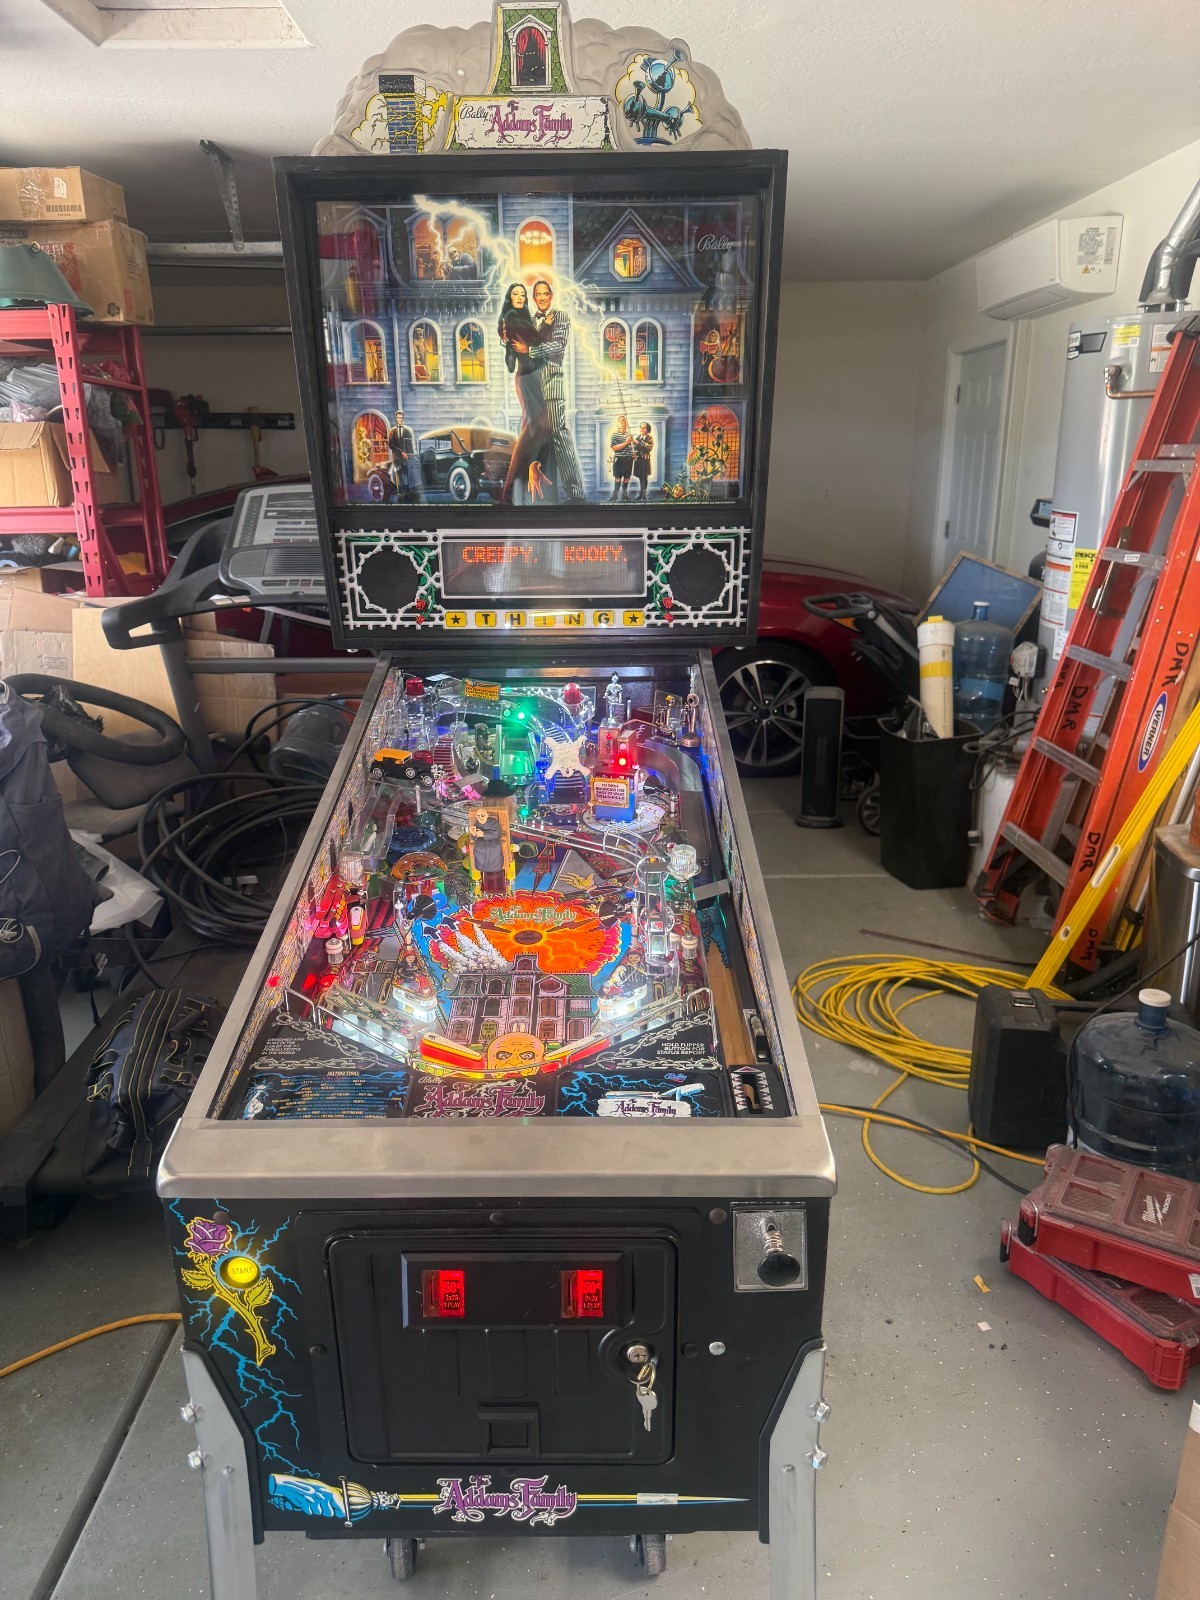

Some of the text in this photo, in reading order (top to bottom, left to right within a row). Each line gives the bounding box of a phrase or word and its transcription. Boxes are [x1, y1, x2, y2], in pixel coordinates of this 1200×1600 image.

[460, 106, 488, 120] Bally
[485, 100, 573, 145] The Addams Family
[698, 233, 734, 255] Bally
[462, 545, 628, 563] CREEPY. KOOKY.
[1060, 685, 1089, 730] DMR
[1142, 709, 1163, 757] WERNER
[1079, 832, 1101, 873] DMR
[483, 906, 539, 926] Addams
[535, 904, 577, 926] Family
[418, 1075, 445, 1084] Bally
[414, 1085, 494, 1118] Addams
[485, 1082, 546, 1117] Family
[611, 1100, 650, 1117] Addams
[648, 1101, 678, 1117] Family
[231, 1267, 253, 1275] START
[432, 1477, 520, 1522] Addams
[509, 1474, 577, 1526] Family
